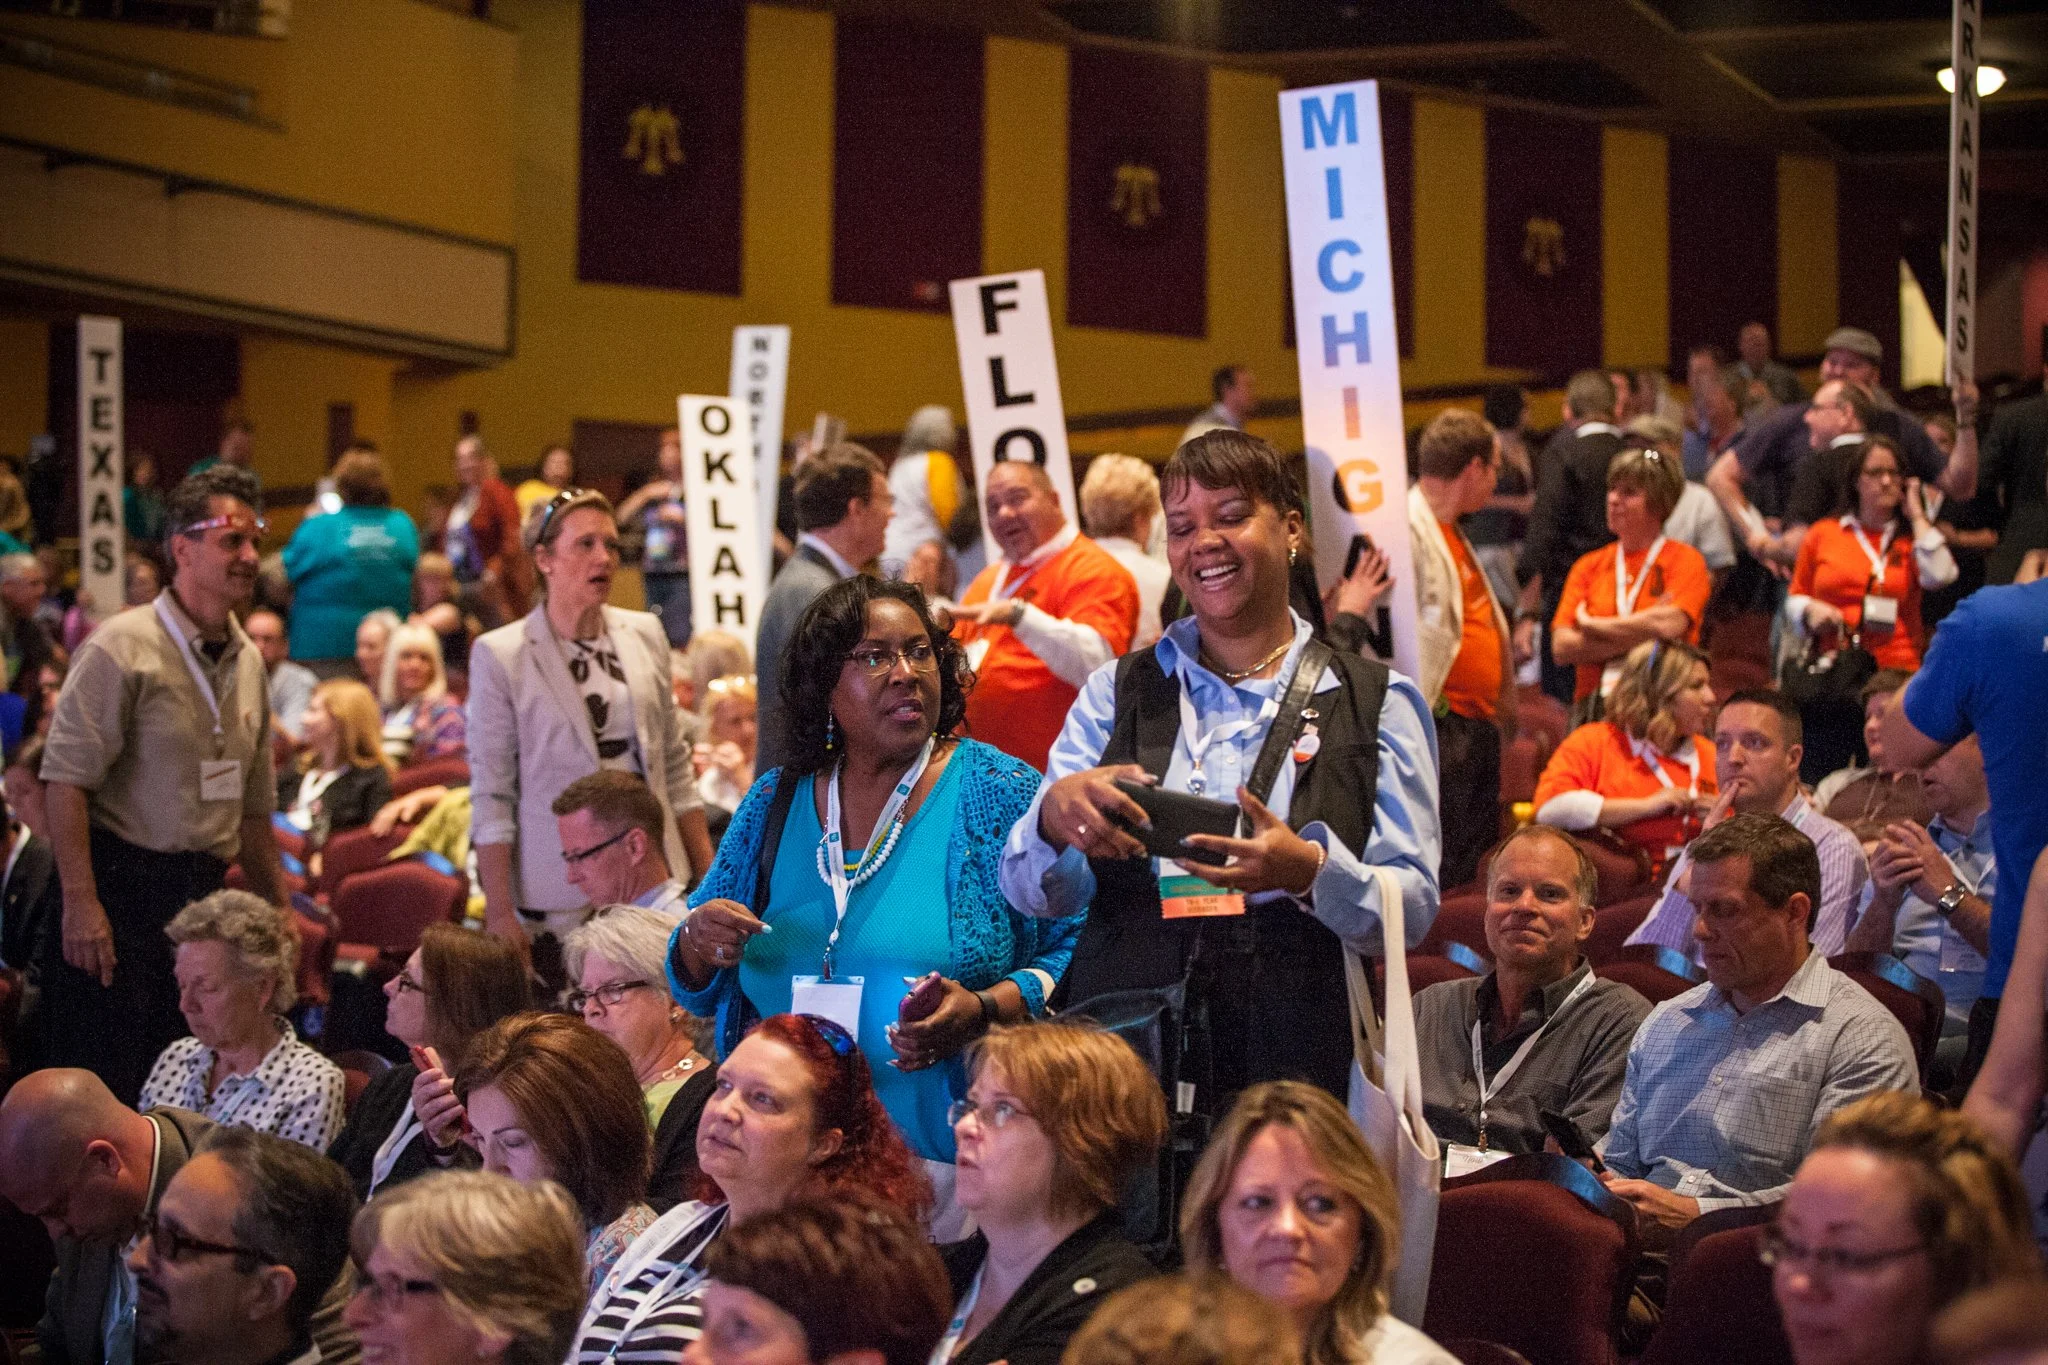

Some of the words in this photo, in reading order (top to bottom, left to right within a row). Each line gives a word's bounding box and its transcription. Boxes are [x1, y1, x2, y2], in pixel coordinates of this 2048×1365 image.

[89, 349, 116, 573] TEXAS
[979, 281, 1047, 467] FLO
[700, 404, 746, 626] OKLAH
